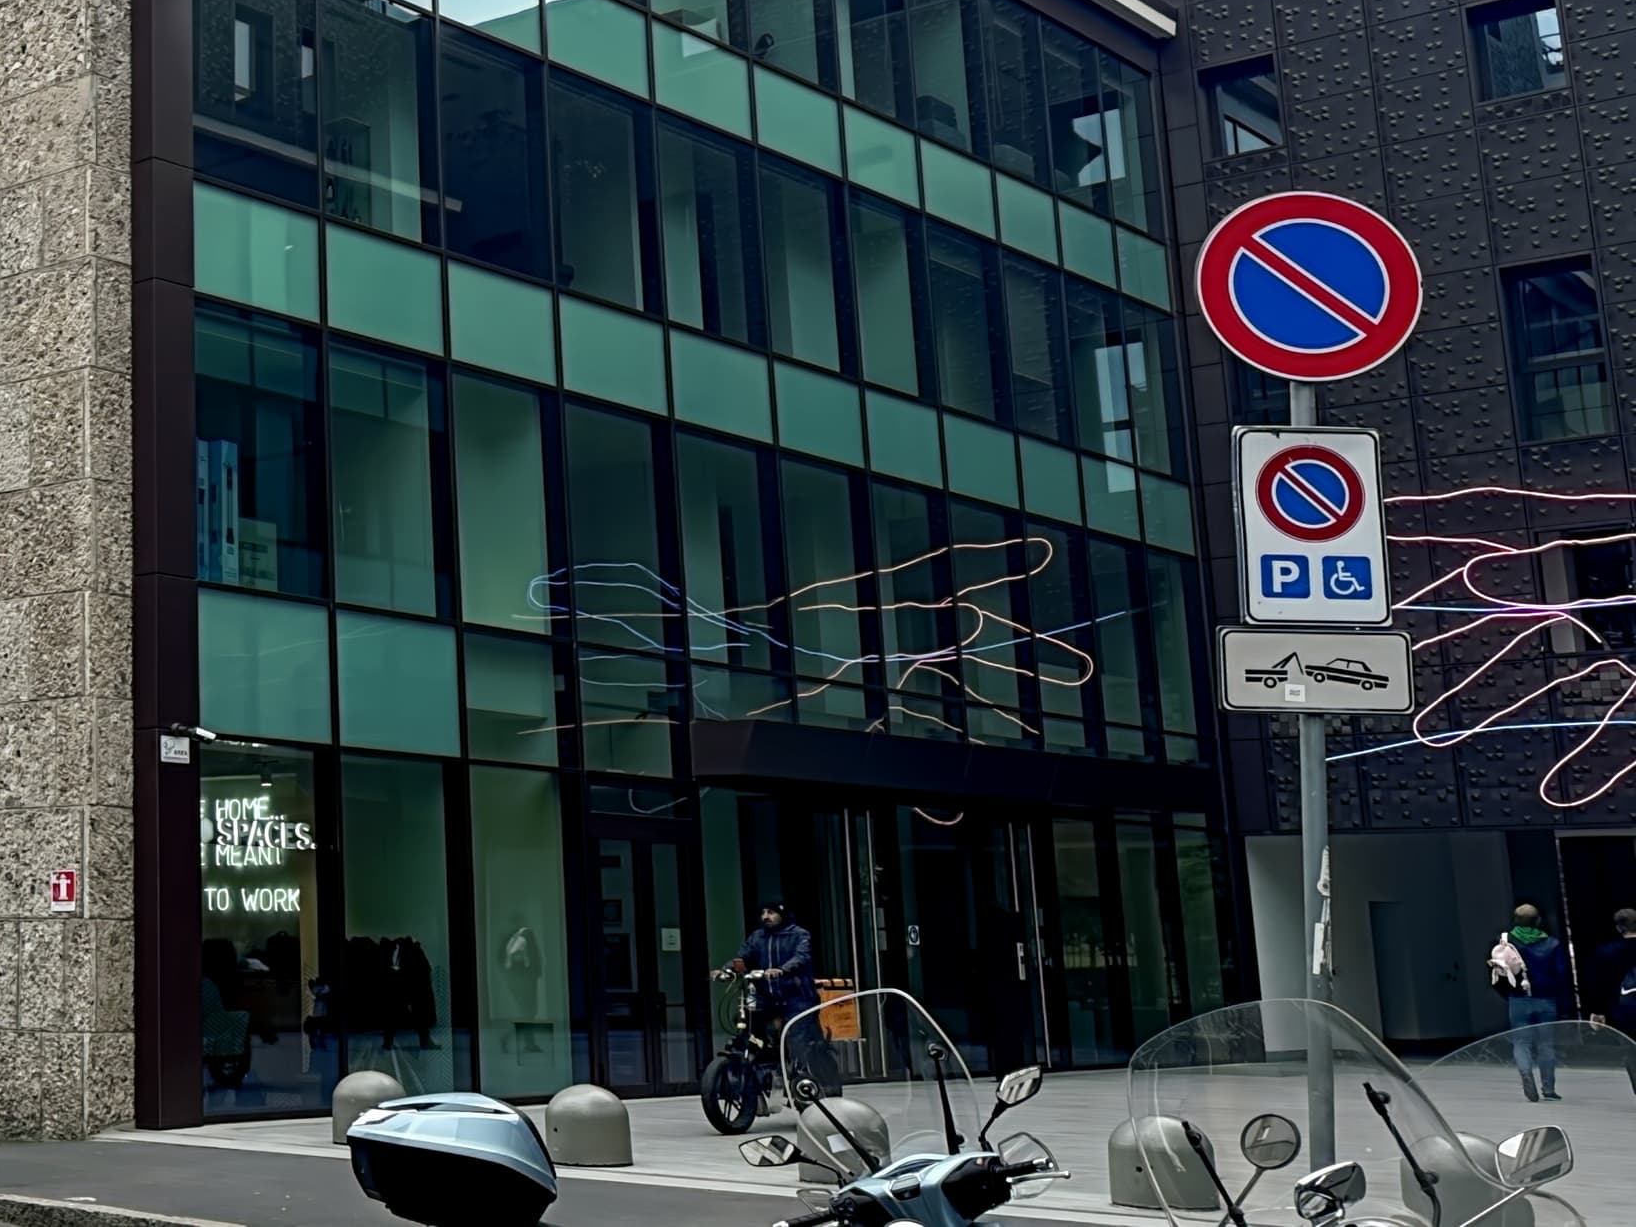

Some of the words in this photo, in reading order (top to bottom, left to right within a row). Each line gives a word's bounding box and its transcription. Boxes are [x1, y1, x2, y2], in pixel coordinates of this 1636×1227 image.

[1271, 560, 1300, 593] P
[203, 888, 231, 911] TO
[240, 887, 302, 912] WORK
